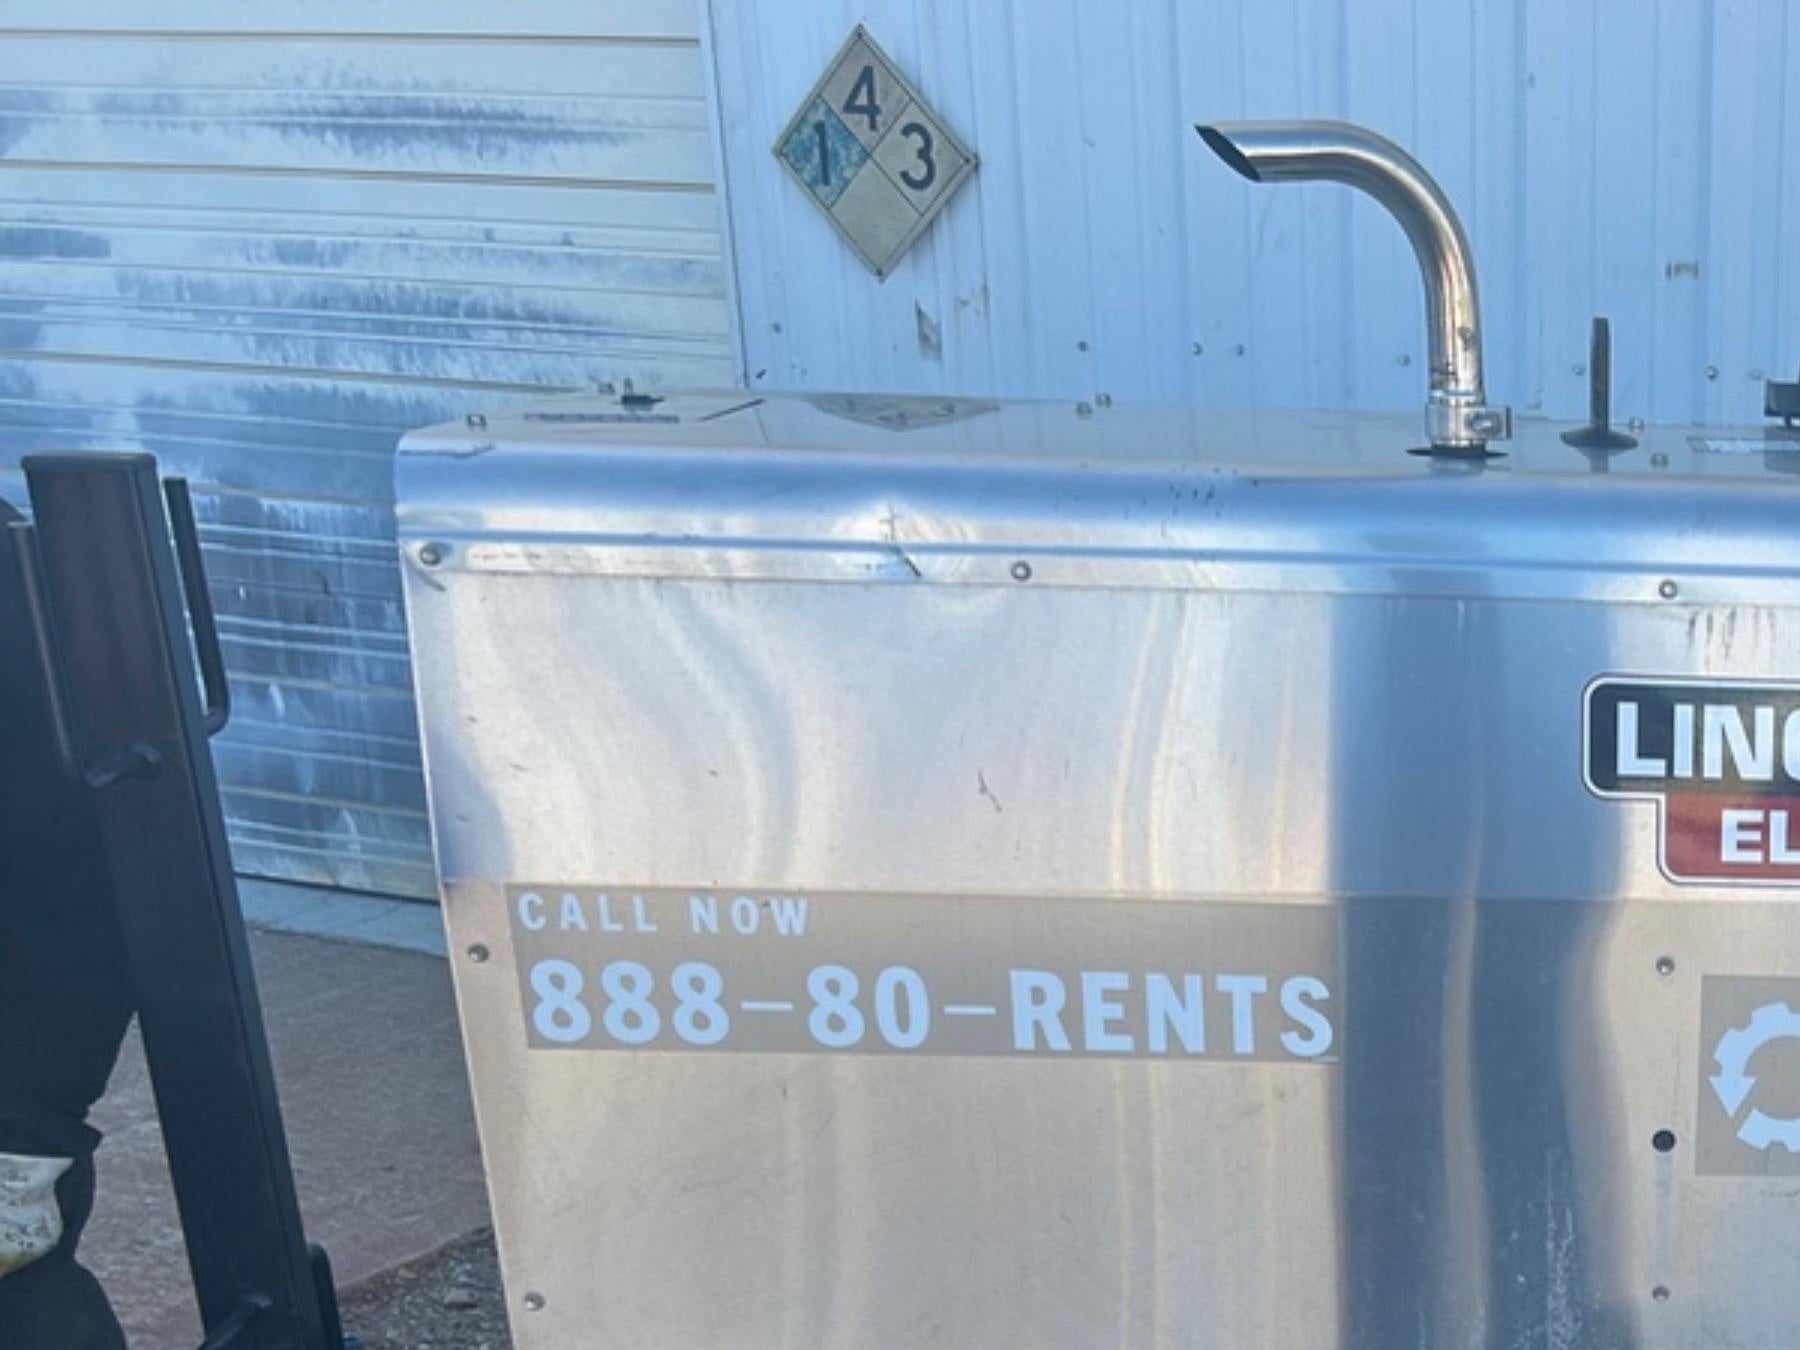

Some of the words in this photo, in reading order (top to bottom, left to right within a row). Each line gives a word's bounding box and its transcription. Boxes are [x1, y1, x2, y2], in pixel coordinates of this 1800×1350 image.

[843, 65, 881, 131] 4
[813, 120, 831, 186] 1
[899, 122, 935, 190] 3
[518, 893, 658, 934] CALL
[691, 897, 809, 936] NOW
[530, 959, 1334, 1056] 888-80-RENTS
